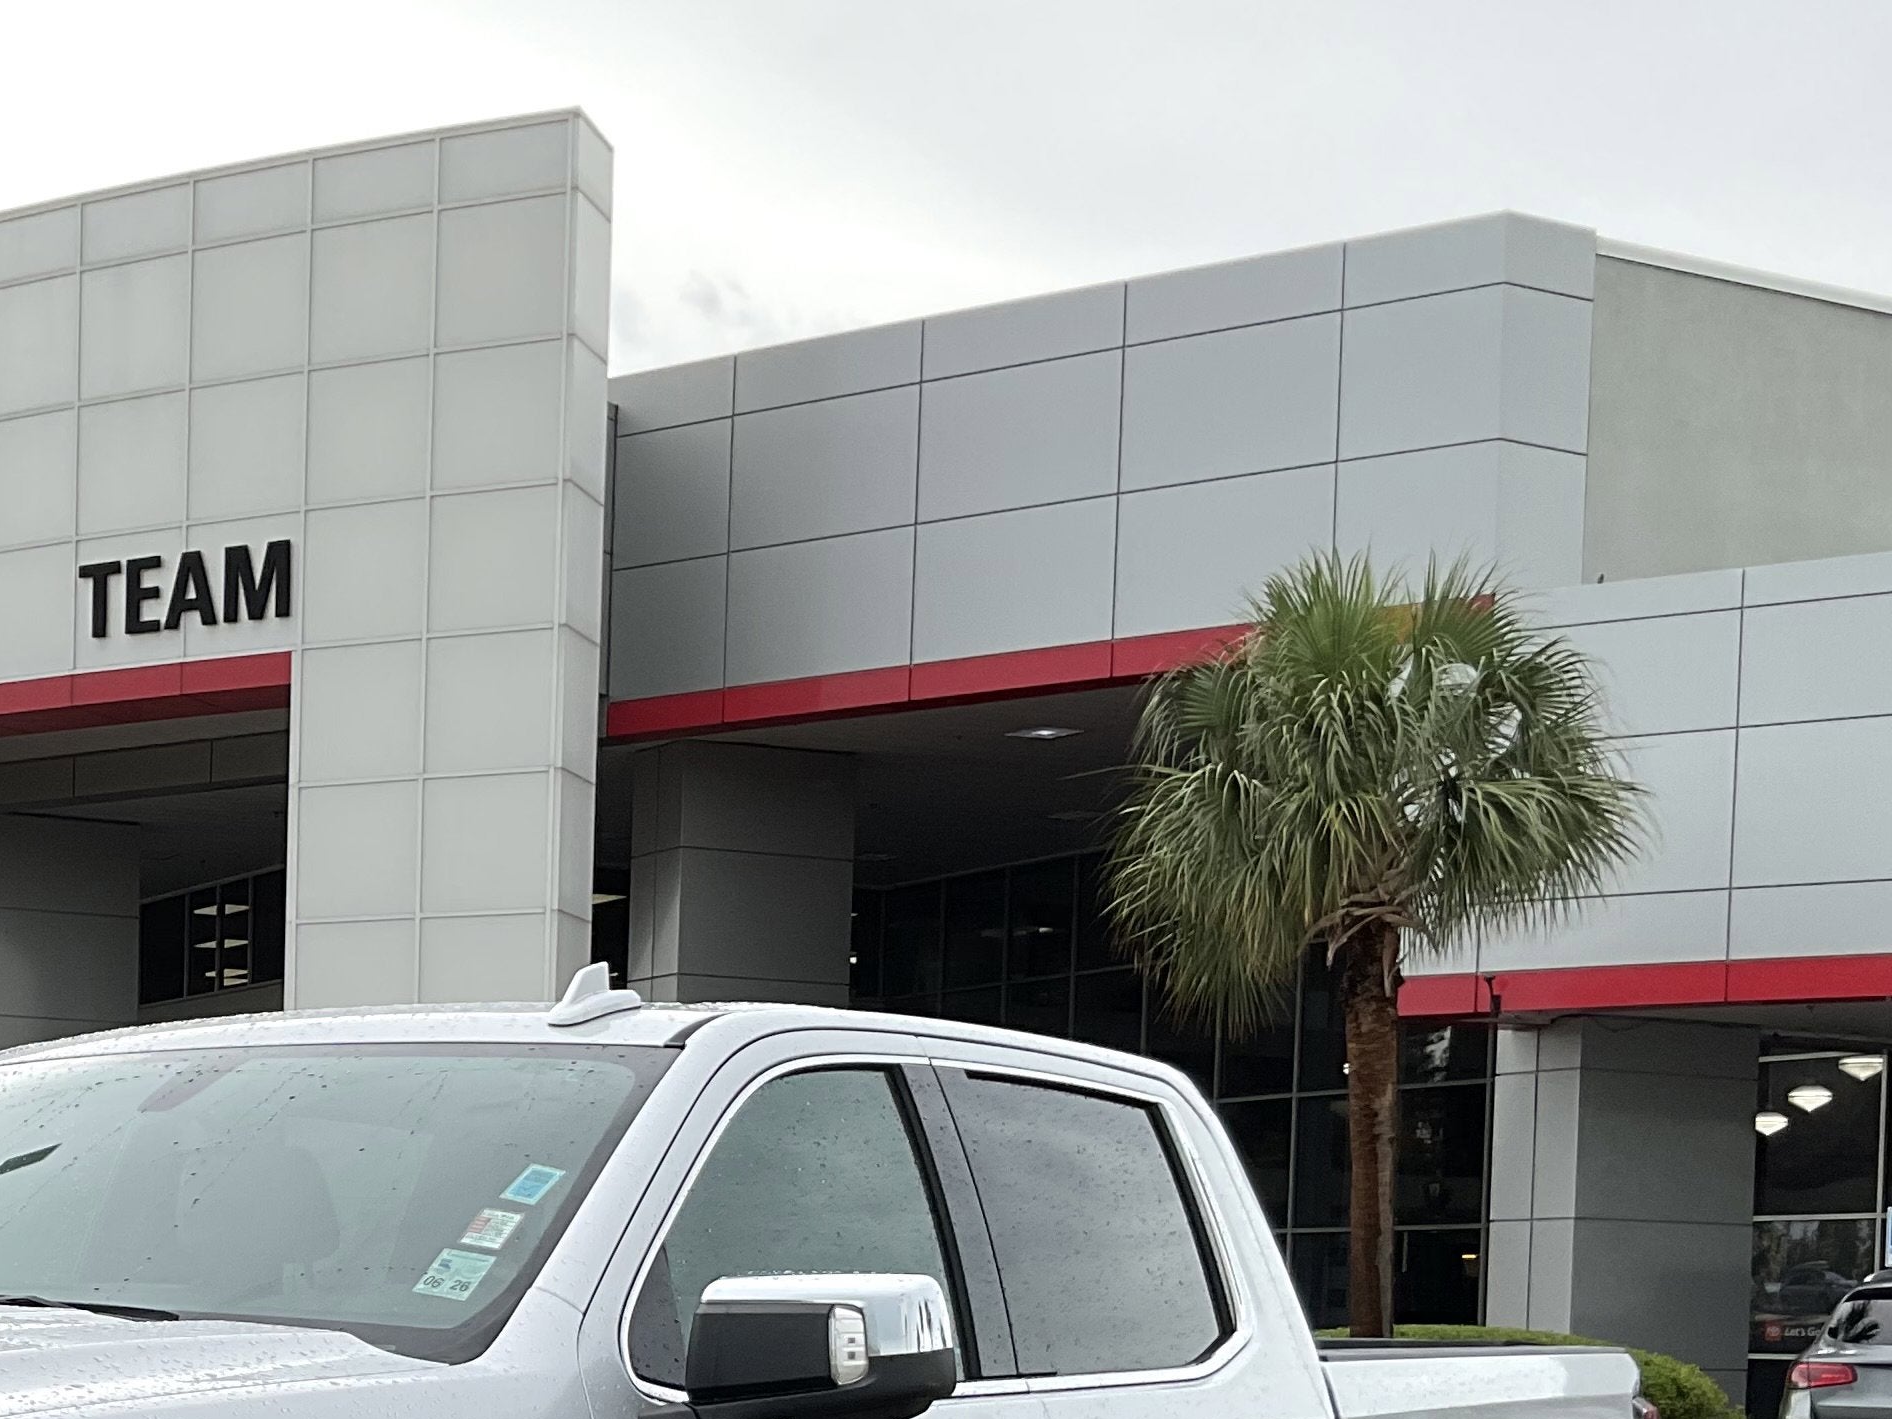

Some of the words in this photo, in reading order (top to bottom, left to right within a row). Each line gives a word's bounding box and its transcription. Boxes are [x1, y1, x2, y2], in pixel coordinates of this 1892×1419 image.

[78, 539, 292, 639] TEAM
[423, 1275, 444, 1289] 06
[449, 1279, 471, 1292] 26
